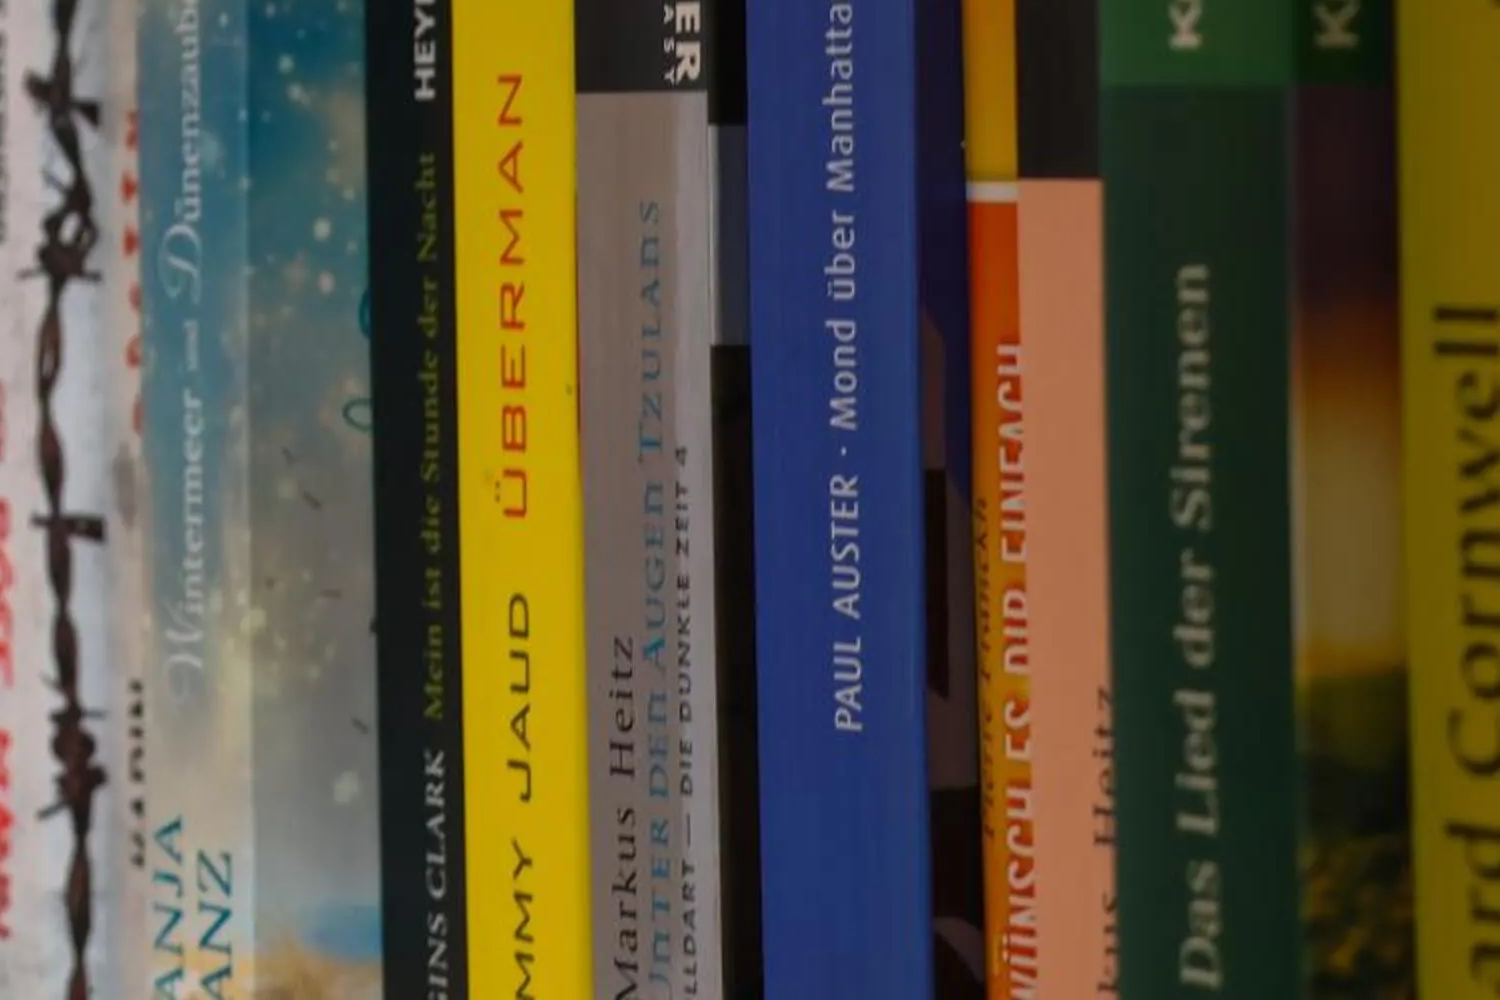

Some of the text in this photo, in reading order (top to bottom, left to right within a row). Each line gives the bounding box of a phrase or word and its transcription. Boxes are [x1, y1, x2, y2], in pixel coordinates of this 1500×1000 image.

[415, 151, 438, 265] Nacht
[825, 208, 857, 303] über
[416, 276, 440, 339] der
[495, 72, 528, 519] ÜBERMAN
[418, 348, 442, 484] Stunde
[826, 316, 858, 433] Mond
[674, 445, 689, 468] 4
[160, 387, 204, 694] Wintermeer
[419, 495, 442, 555] die
[674, 478, 691, 557] ZEIT
[829, 472, 861, 621] AUSTER
[1432, 304, 1500, 778] Cornwell
[420, 564, 443, 611] ist
[1170, 264, 1222, 990] Das Lied der Sirenen
[421, 624, 445, 722] Mein
[507, 592, 532, 803] JAUD
[675, 574, 693, 724] DUNKLE
[834, 634, 863, 732] PAUL
[423, 747, 448, 900] CLARK
[609, 634, 639, 1000] Markus Heitz
[679, 741, 694, 799] DIE
